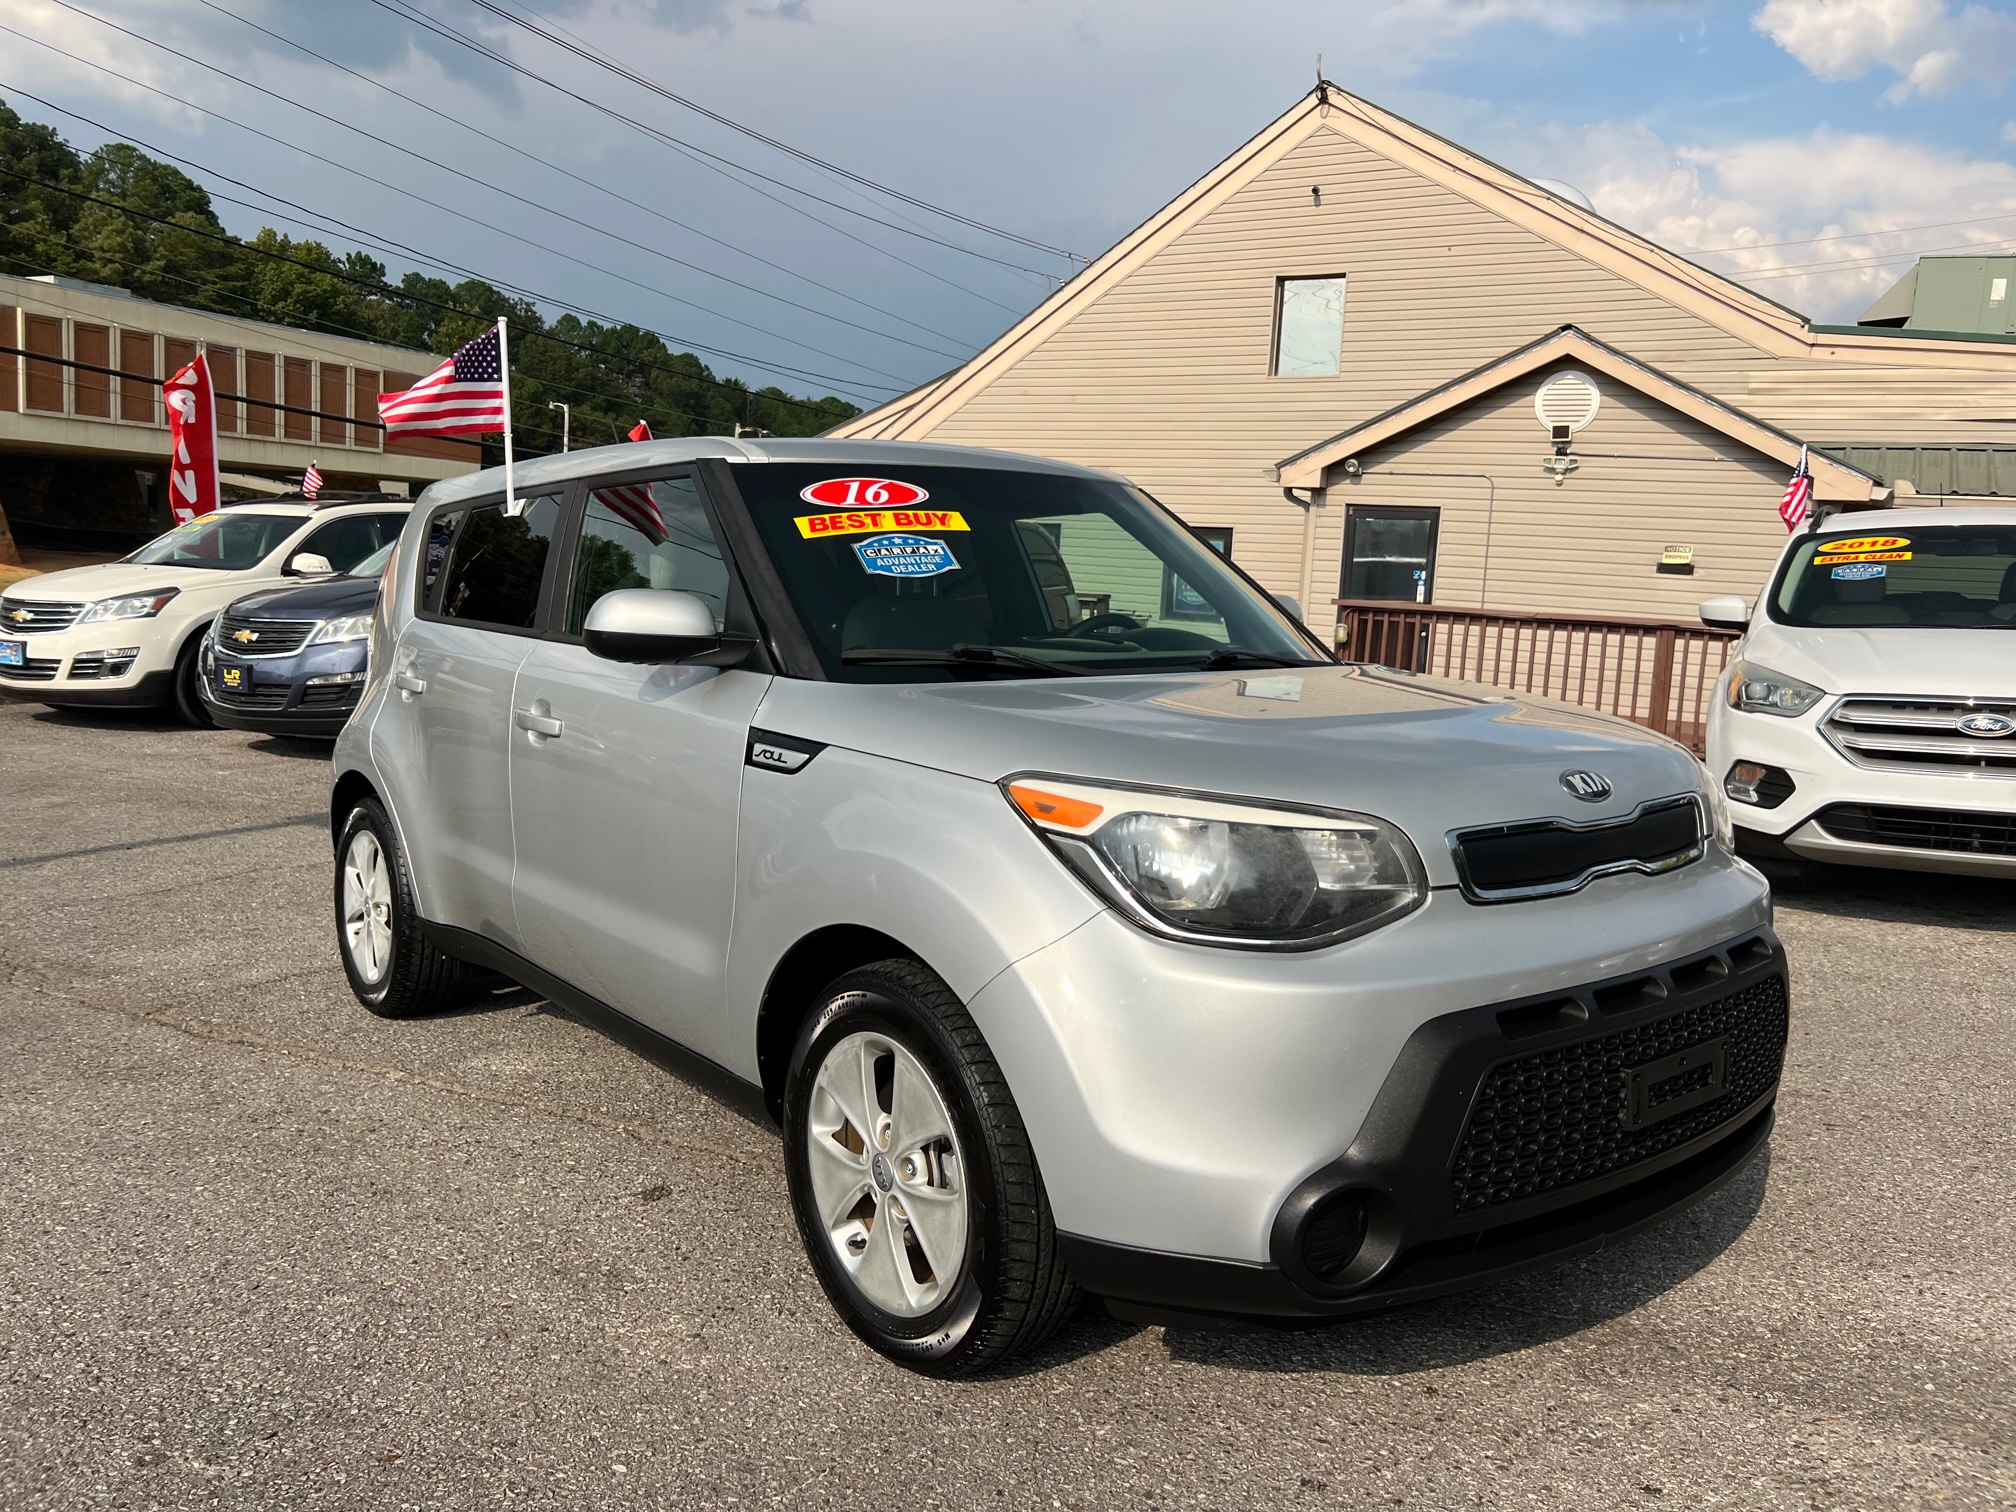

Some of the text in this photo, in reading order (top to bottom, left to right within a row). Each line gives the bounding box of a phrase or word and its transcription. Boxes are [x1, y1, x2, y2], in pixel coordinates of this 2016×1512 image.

[839, 481, 890, 505] 16
[808, 512, 951, 533] BEST BUY
[1829, 539, 1898, 550] 2018
[864, 546, 944, 558] CARFAX
[1820, 553, 1905, 563] EXTRA CLEAN
[876, 556, 943, 567] ADVANTAGE
[891, 564, 937, 573] DEALER
[223, 668, 240, 680] LR
[1971, 716, 2002, 730] Ford
[1566, 772, 1609, 794] KIA
